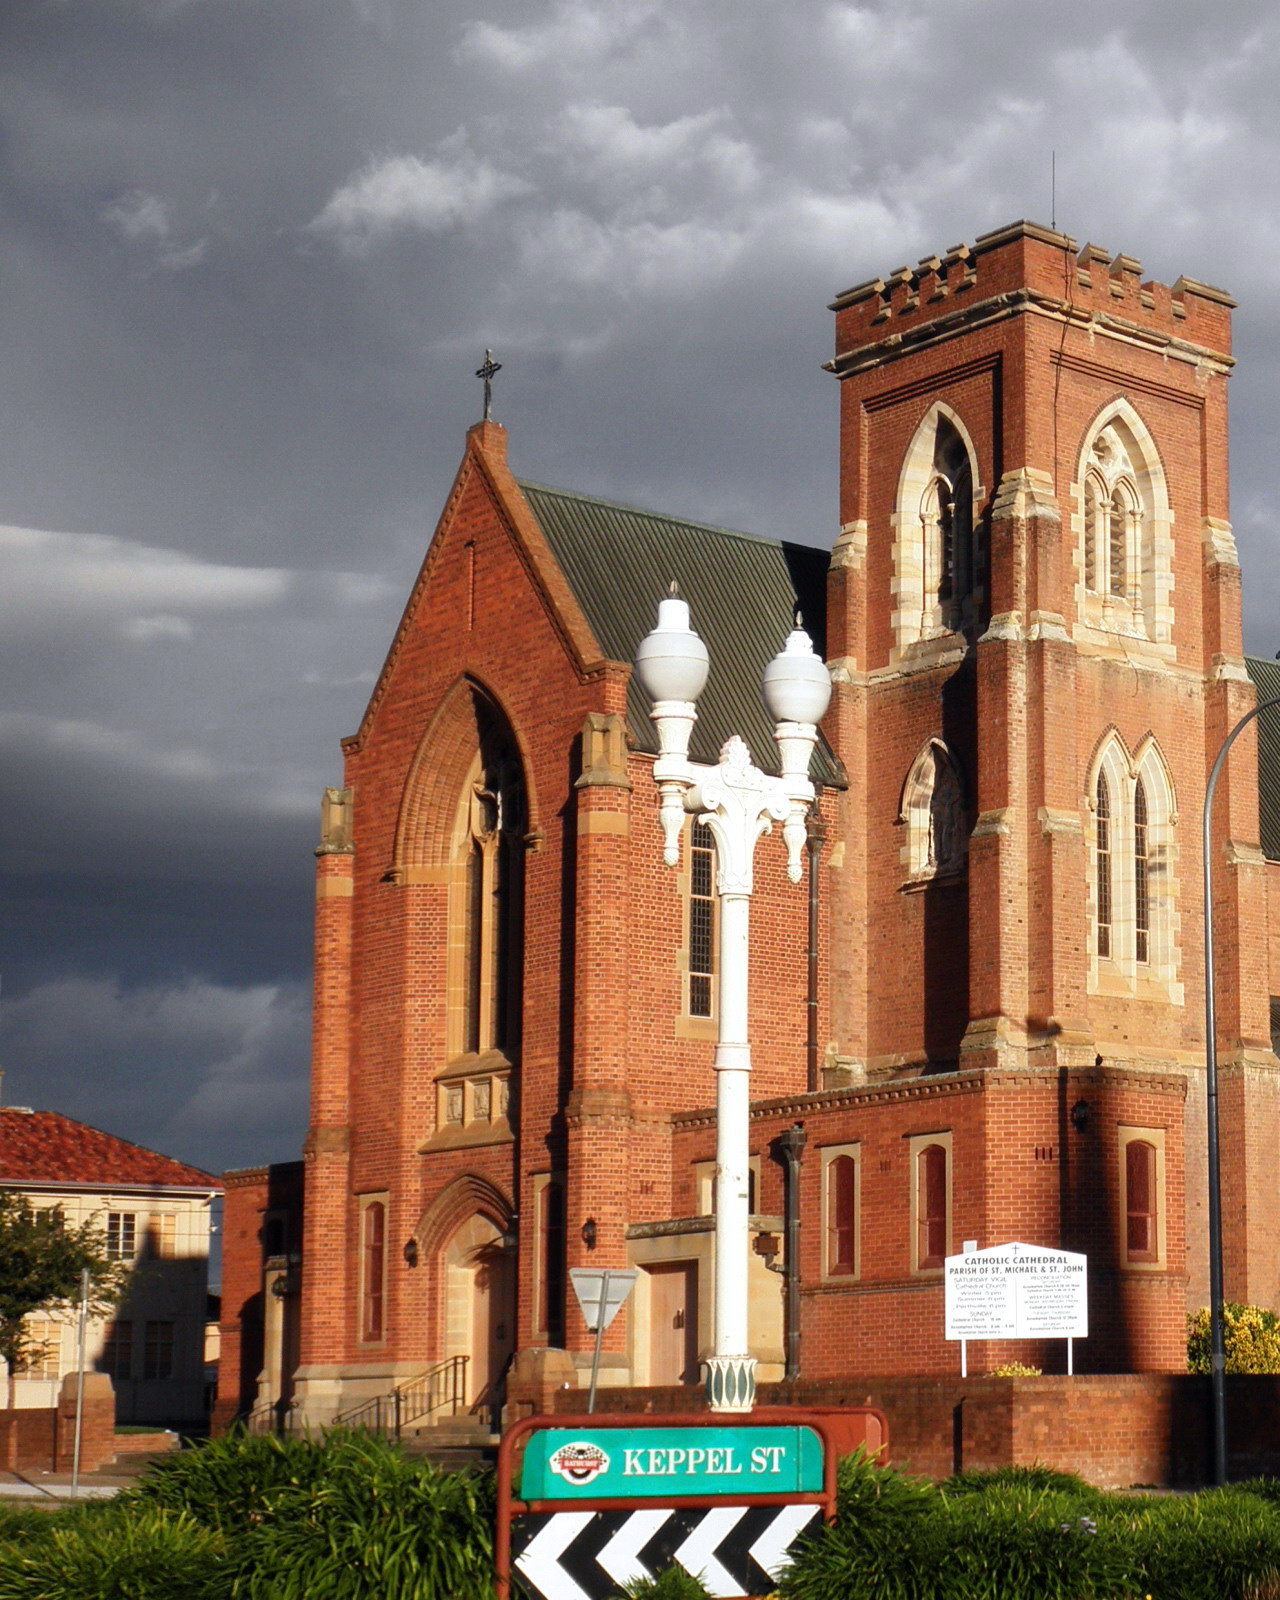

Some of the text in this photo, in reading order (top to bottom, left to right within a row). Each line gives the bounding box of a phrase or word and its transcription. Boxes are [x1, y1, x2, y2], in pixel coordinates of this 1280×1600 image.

[965, 1256, 1068, 1265] CATHOLIC CATHEDRAL
[949, 1267, 977, 1275] PARISH
[622, 1446, 786, 1476] KEPPEL ST
